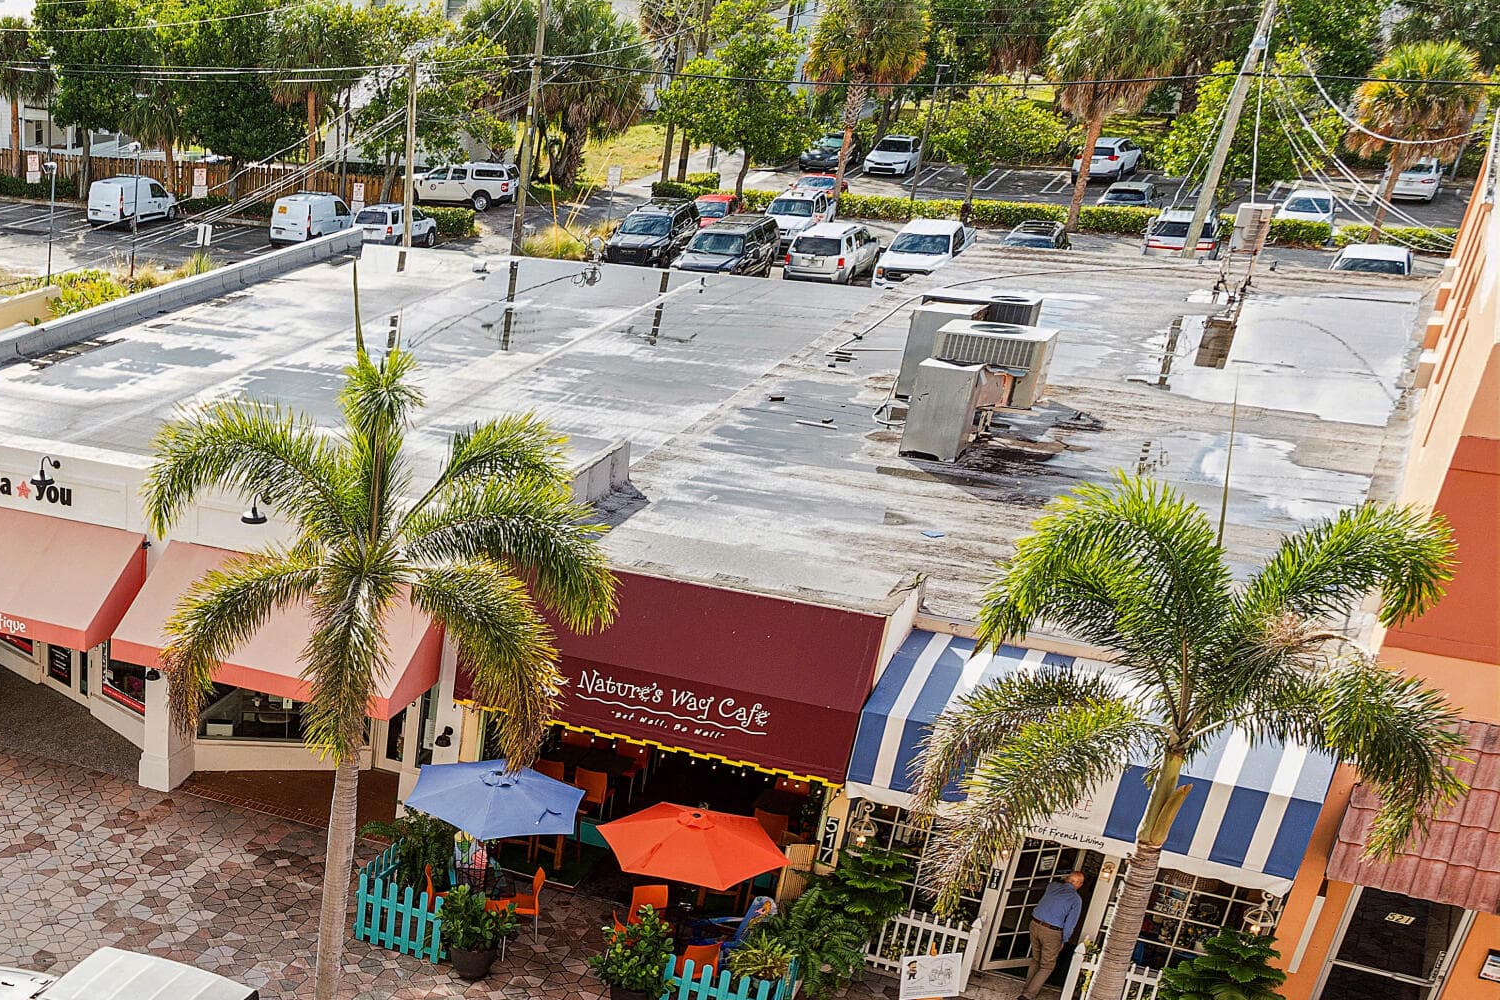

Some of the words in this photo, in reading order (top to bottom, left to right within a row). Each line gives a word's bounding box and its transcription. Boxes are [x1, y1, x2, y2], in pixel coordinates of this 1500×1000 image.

[577, 669, 664, 703] Nature's
[671, 689, 714, 719] Way
[821, 816, 839, 862] 517
[1040, 826, 1049, 835] of
[1049, 828, 1078, 841] French
[1079, 834, 1105, 848] Living
[1386, 912, 1414, 924] 521
